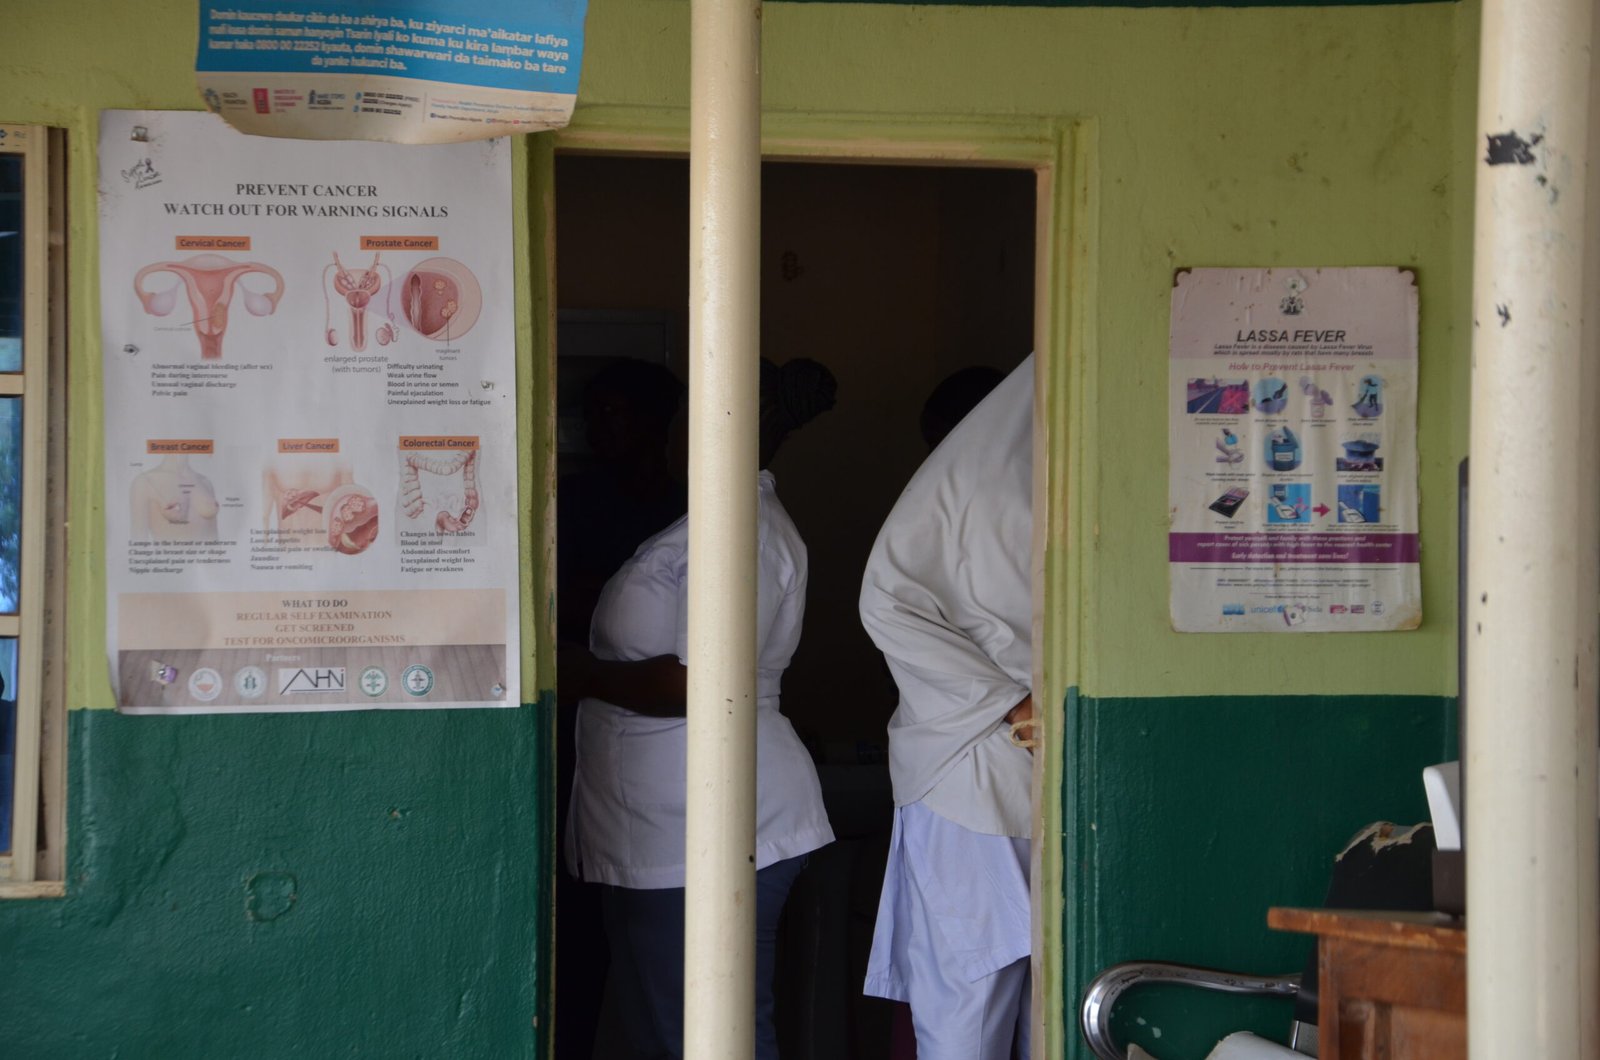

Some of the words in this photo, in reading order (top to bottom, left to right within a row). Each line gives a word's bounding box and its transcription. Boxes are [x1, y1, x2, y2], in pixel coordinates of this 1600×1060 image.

[408, 18, 423, 30] ku
[425, 20, 466, 36] ziyarci
[468, 28, 532, 43] ma'aikatar
[535, 33, 568, 48] lafiya
[396, 31, 410, 42] ko
[412, 33, 446, 46] kuma
[448, 38, 464, 49] ku
[466, 39, 489, 52] kira
[492, 42, 534, 56] lambar
[537, 49, 568, 62] waya
[386, 44, 452, 62] shawarwari
[454, 53, 470, 64] da
[472, 55, 522, 70] taimako
[524, 60, 540, 72] ba
[542, 63, 566, 74] tare
[236, 183, 308, 196] PREVENT
[312, 184, 378, 198] CANCER
[164, 203, 224, 216] WATCH
[228, 204, 262, 216] OUT
[266, 204, 298, 216] FOR
[301, 204, 378, 218] WARNING
[382, 205, 449, 218] SIGNALS
[180, 238, 214, 248] Cervical
[216, 238, 246, 248] Cancer
[366, 238, 402, 248] Prostate
[404, 238, 433, 248] Cancer
[1236, 330, 1289, 342] LASSA
[1294, 330, 1346, 342] FEVER
[324, 354, 356, 364] enlarged
[358, 355, 388, 364] prostate
[332, 366, 351, 374] (with
[1262, 362, 1298, 370] Prevent
[1300, 362, 1326, 370] Lassa
[1328, 362, 1355, 370] Fever
[151, 442, 179, 450] Breast
[403, 439, 446, 448] Colorectal
[447, 440, 476, 448] Cancer
[282, 600, 313, 608] WHAT
[316, 600, 330, 608] TO
[332, 600, 348, 608] DO
[236, 612, 288, 621] REGULAR
[290, 612, 318, 620] SELF
[318, 610, 392, 620] EXAMINATION
[275, 624, 296, 632] GET
[299, 624, 354, 632] SCREENED
[224, 637, 250, 646] TEST
[252, 637, 274, 646] FOR
[276, 634, 406, 646] ONCOMICROORGANISMS
